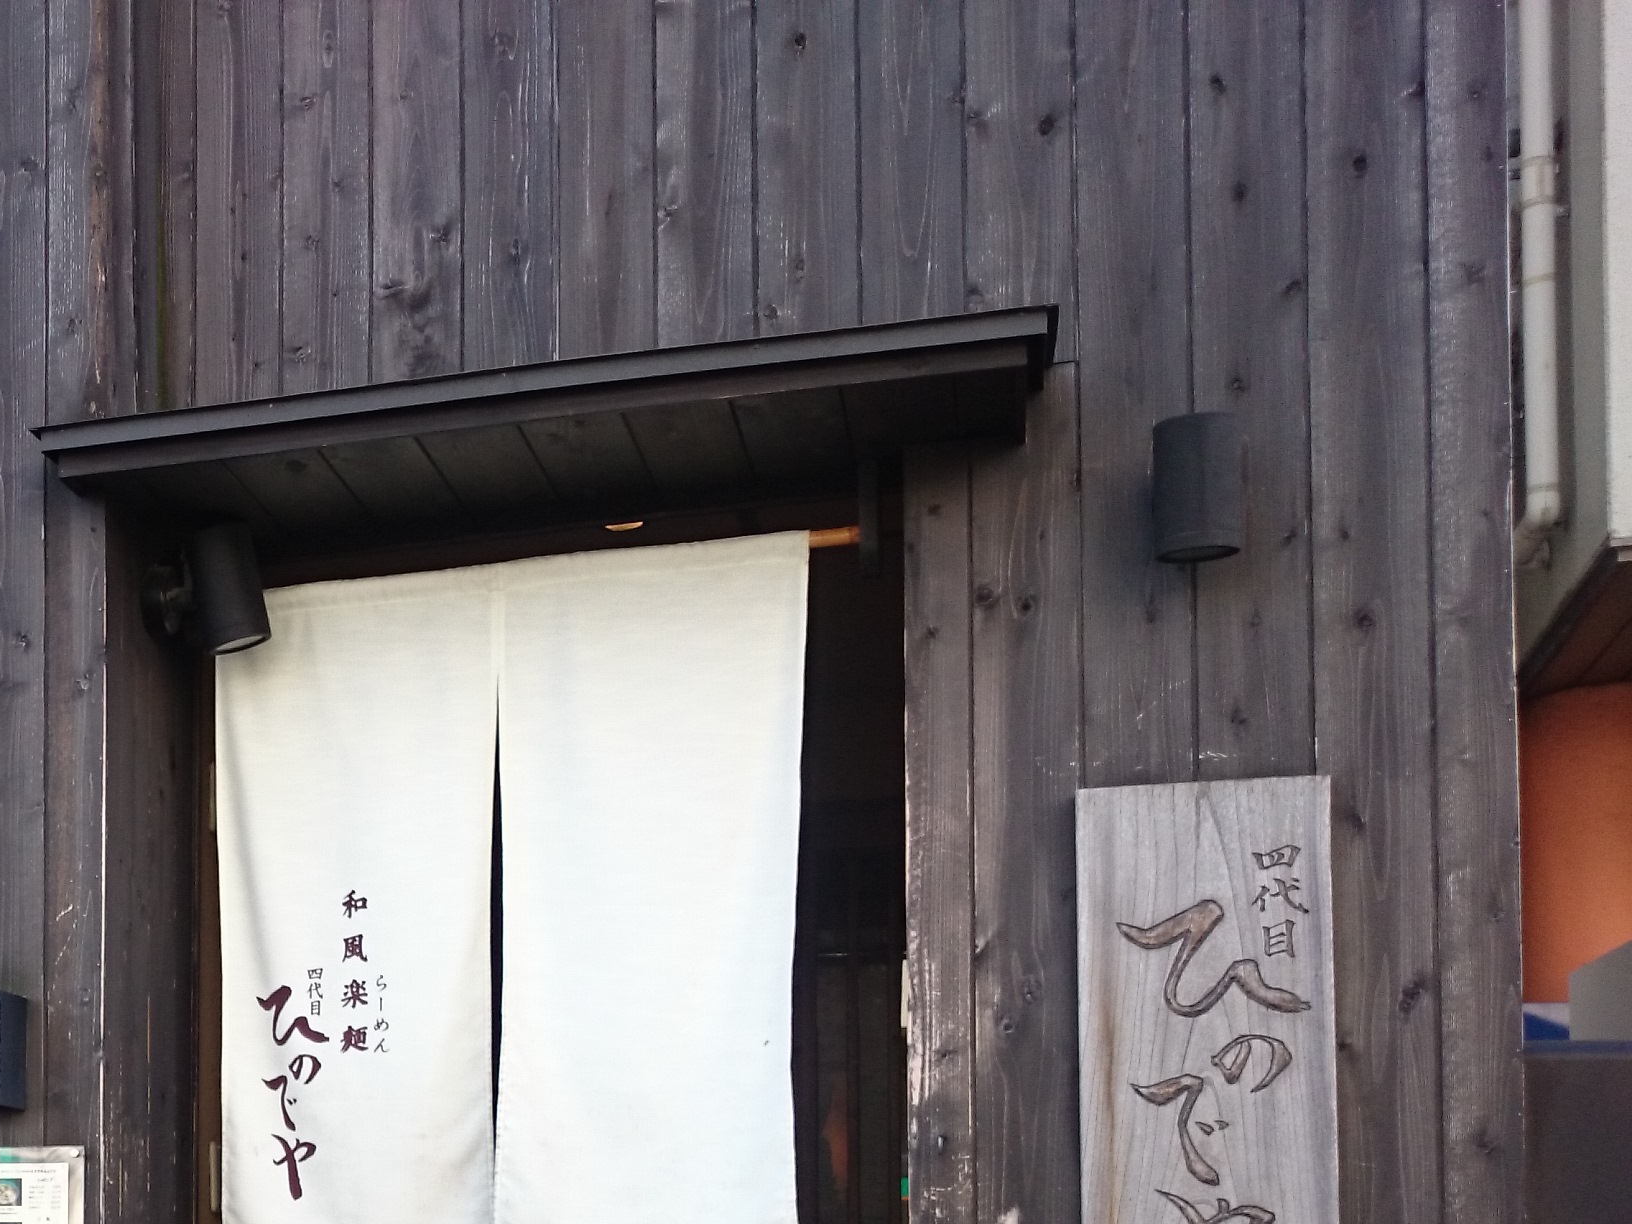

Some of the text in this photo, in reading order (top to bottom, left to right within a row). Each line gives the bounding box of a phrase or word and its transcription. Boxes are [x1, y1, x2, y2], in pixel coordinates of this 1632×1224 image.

[1251, 844, 1310, 958] 四代目
[307, 968, 324, 1016] 四代目
[340, 889, 368, 1053] 和風楽麺
[373, 974, 390, 1053] らーめん
[256, 985, 329, 1200] ひのでや
